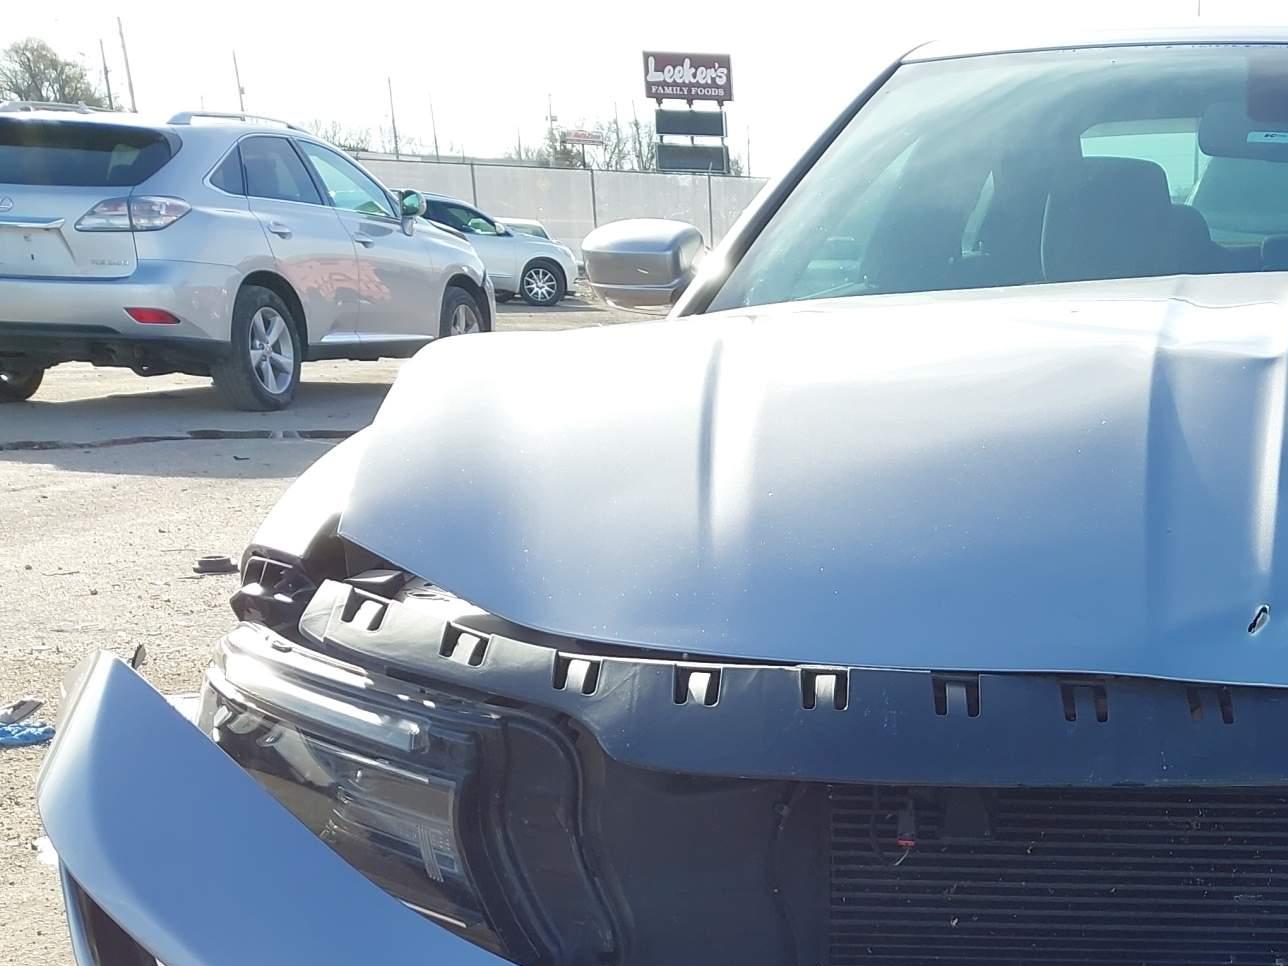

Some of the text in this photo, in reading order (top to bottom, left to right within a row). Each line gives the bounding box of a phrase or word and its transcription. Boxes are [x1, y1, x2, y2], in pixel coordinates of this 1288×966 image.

[646, 56, 728, 85] Leeker's
[651, 85, 724, 96] FAMILY FOODS
